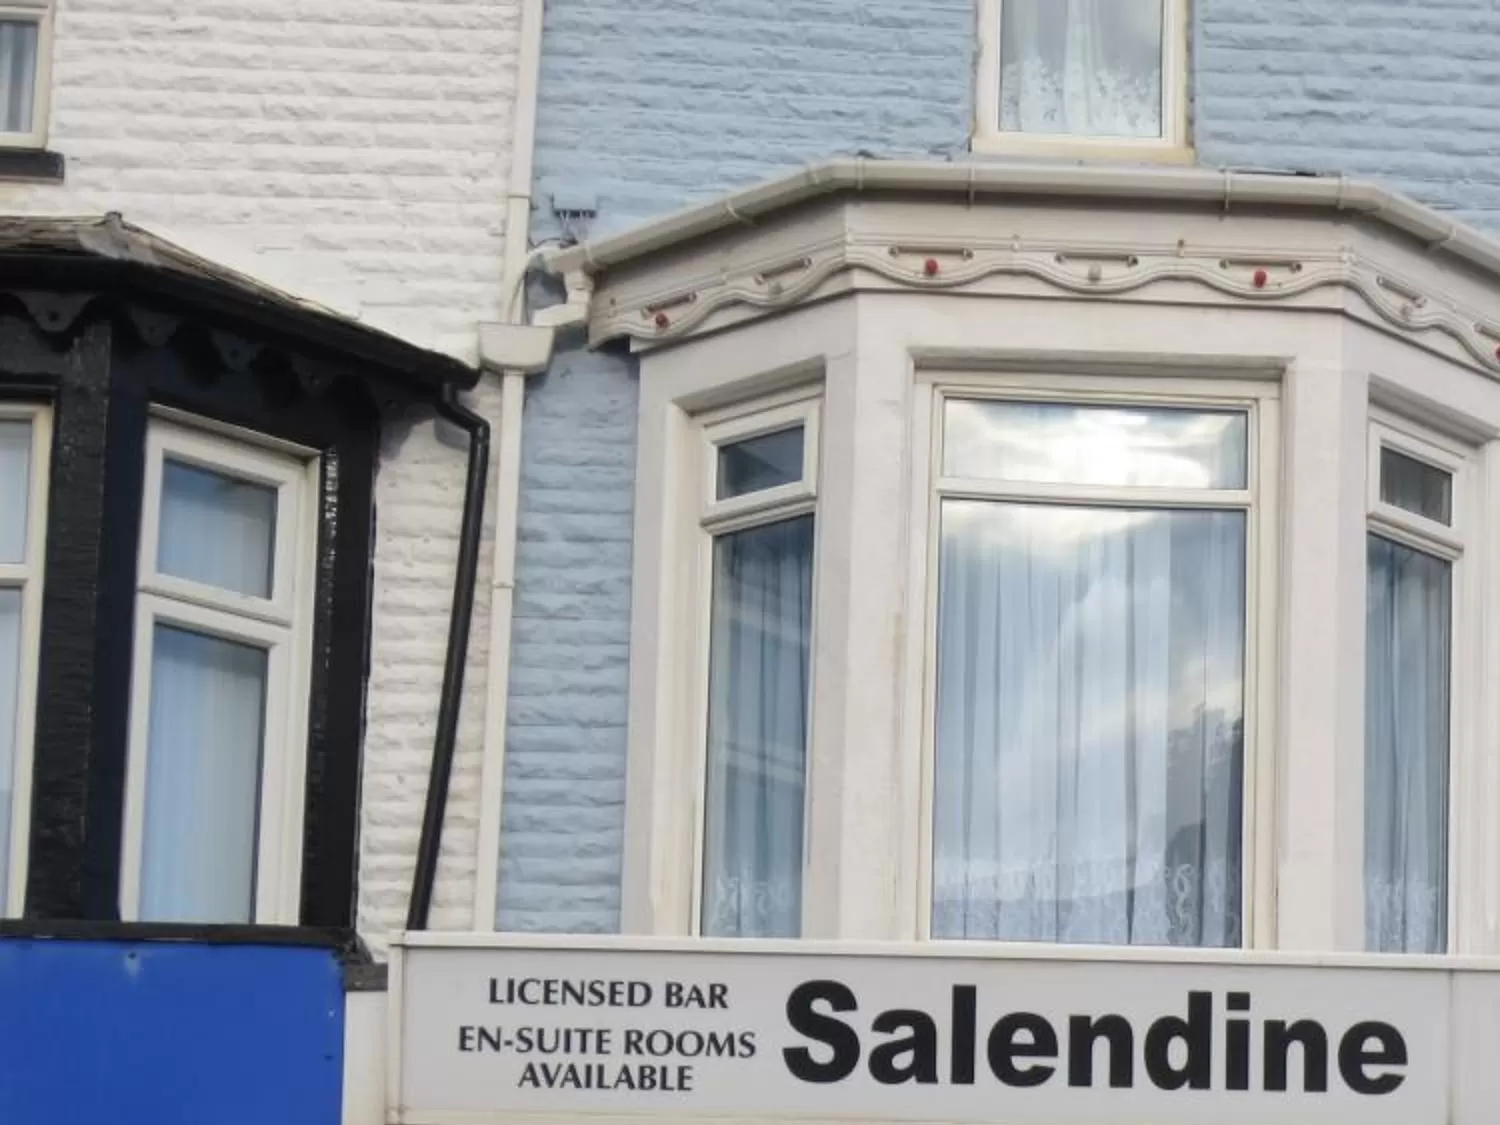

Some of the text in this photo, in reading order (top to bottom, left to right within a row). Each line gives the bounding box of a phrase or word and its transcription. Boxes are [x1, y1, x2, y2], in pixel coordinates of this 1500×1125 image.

[490, 978, 728, 1009] LICENSED BAR
[458, 1026, 756, 1058] EN-SUITE ROOMS
[783, 979, 1408, 1095] Salendine
[518, 1062, 693, 1092] AVAILABLE
